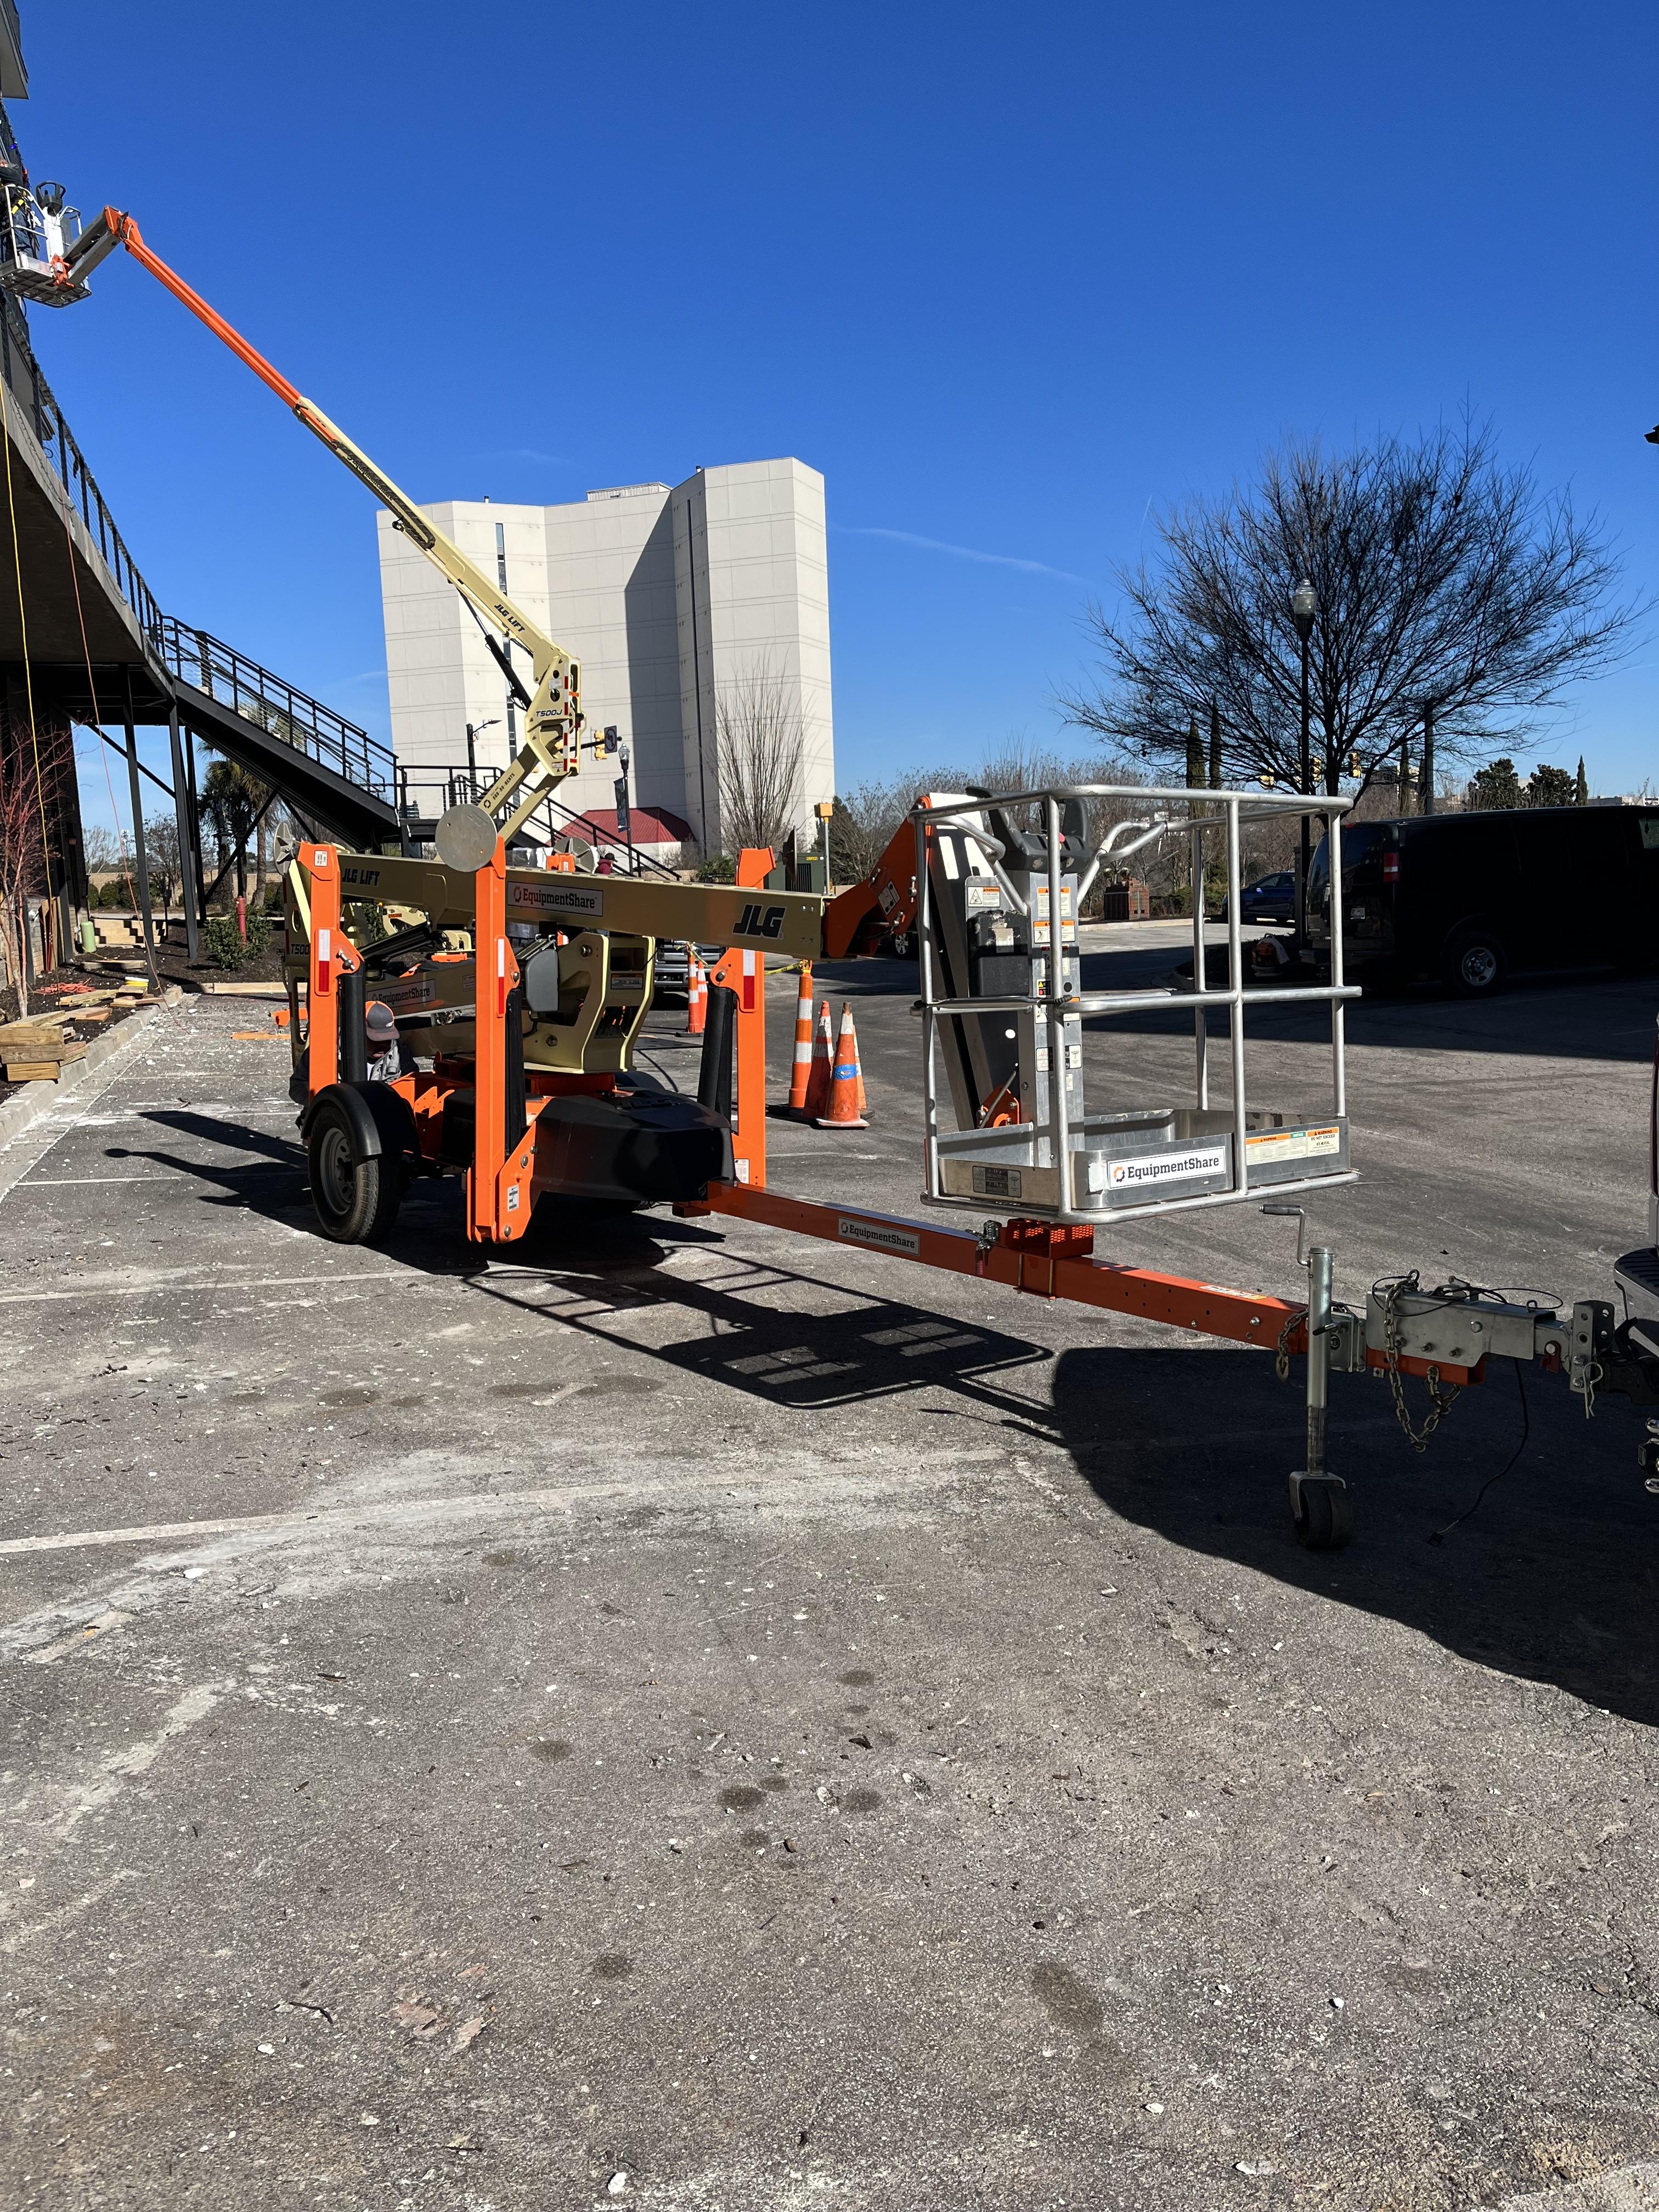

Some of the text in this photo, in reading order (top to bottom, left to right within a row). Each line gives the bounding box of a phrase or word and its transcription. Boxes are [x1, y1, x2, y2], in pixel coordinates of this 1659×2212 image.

[494, 604, 525, 631] JLG LIFT
[535, 709, 562, 717] T500J
[342, 868, 381, 886] JLG LIFT
[523, 888, 595, 909] EquipmentShare
[732, 904, 786, 938] JLG
[379, 987, 430, 1005] EquipmentShare
[1128, 1158, 1219, 1179] EquipmentShare
[849, 1224, 915, 1248] EquipmentShare
